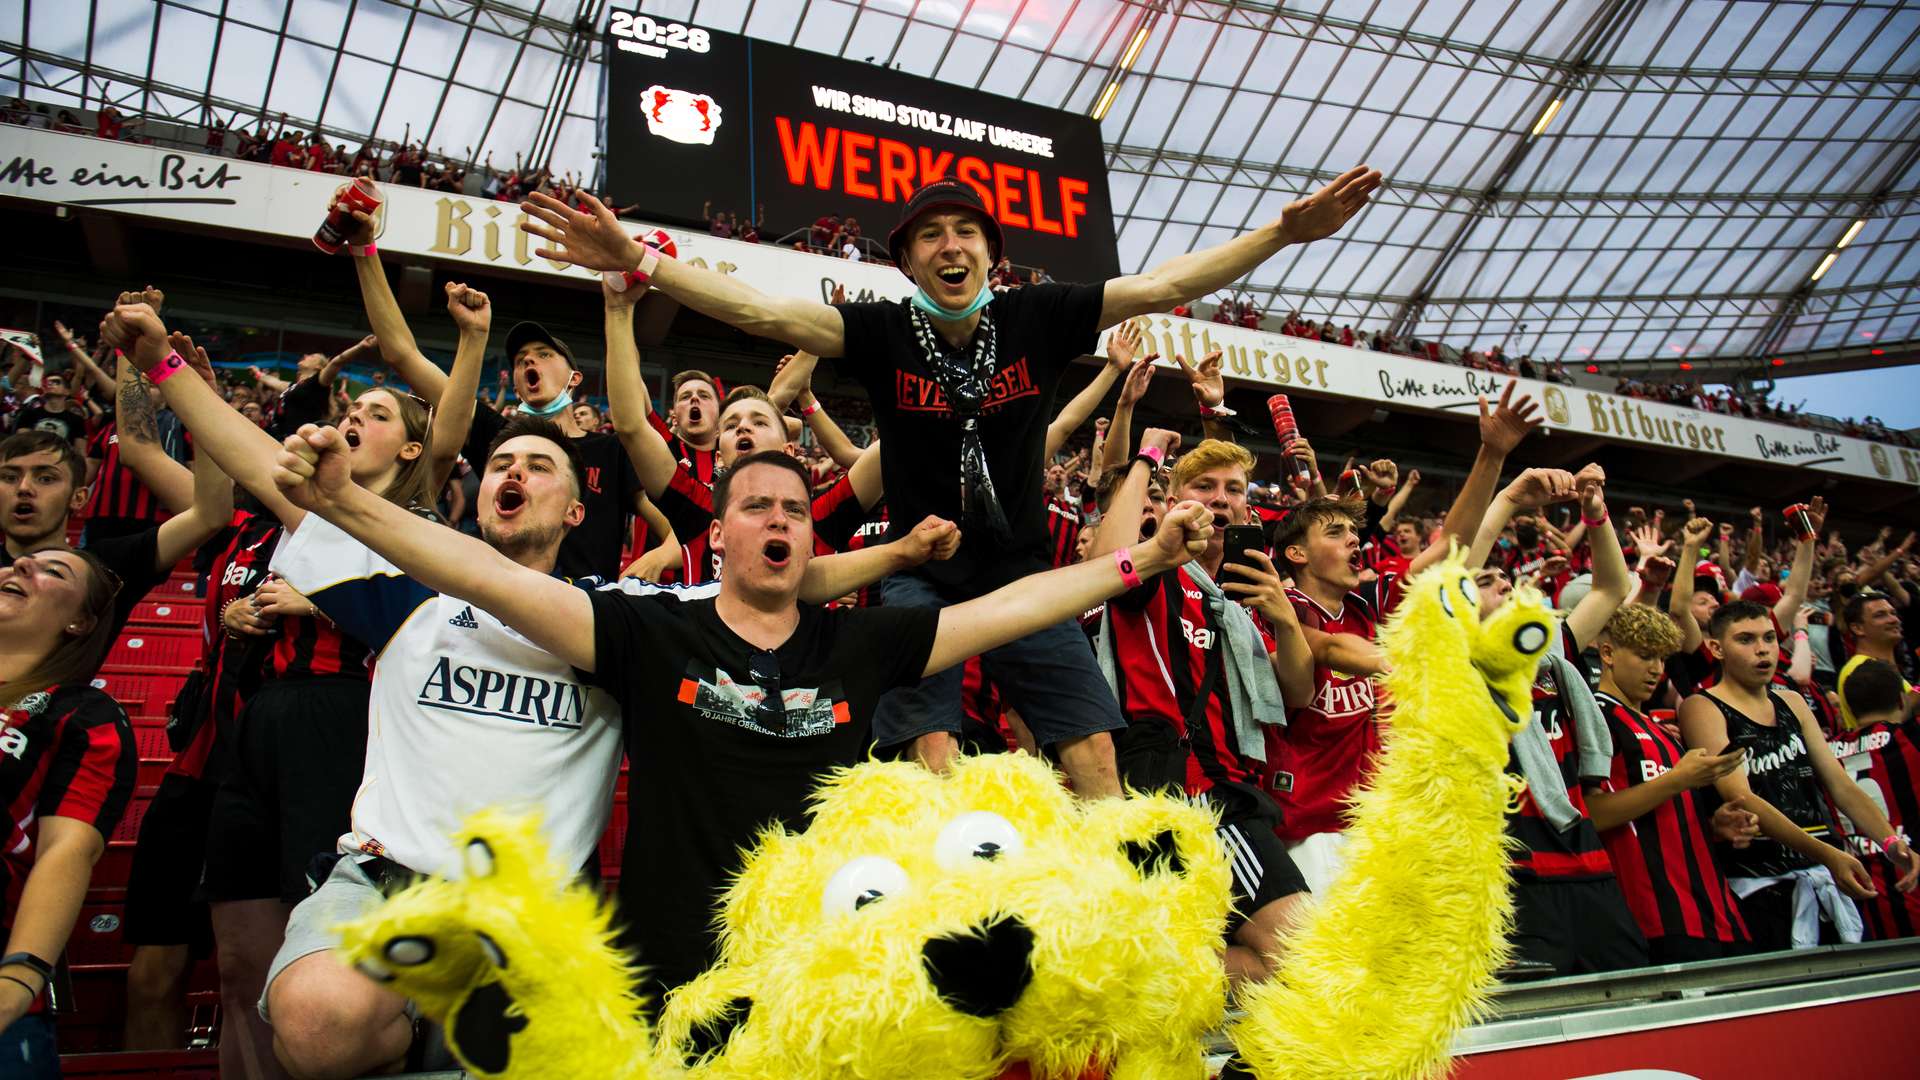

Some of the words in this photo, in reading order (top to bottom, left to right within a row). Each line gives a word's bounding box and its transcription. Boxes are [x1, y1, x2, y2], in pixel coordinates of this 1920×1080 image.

[610, 11, 711, 54] 20:28
[812, 85, 851, 113] WIR
[852, 94, 897, 123] SIND
[896, 105, 953, 136] STOLZ
[953, 117, 987, 143] AUF
[987, 125, 1055, 158] UNSERE
[69, 163, 150, 187] ein
[160, 154, 242, 190] Bit
[775, 116, 1089, 239] WERKSELF
[1131, 314, 1330, 388] Bitburger
[1379, 370, 1428, 398] Bitte
[1432, 379, 1465, 396] ein
[1466, 371, 1502, 396] Bit
[1586, 393, 1726, 452] Bitburger
[1755, 433, 1792, 459] Bitte
[1793, 441, 1817, 455] ein
[1814, 433, 1841, 455] Bit
[1083, 604, 1105, 620] JAKO
[418, 656, 592, 726] ASPIRIN
[711, 712, 737, 727] JAHRE
[799, 726, 832, 738] AUFSTIEG
